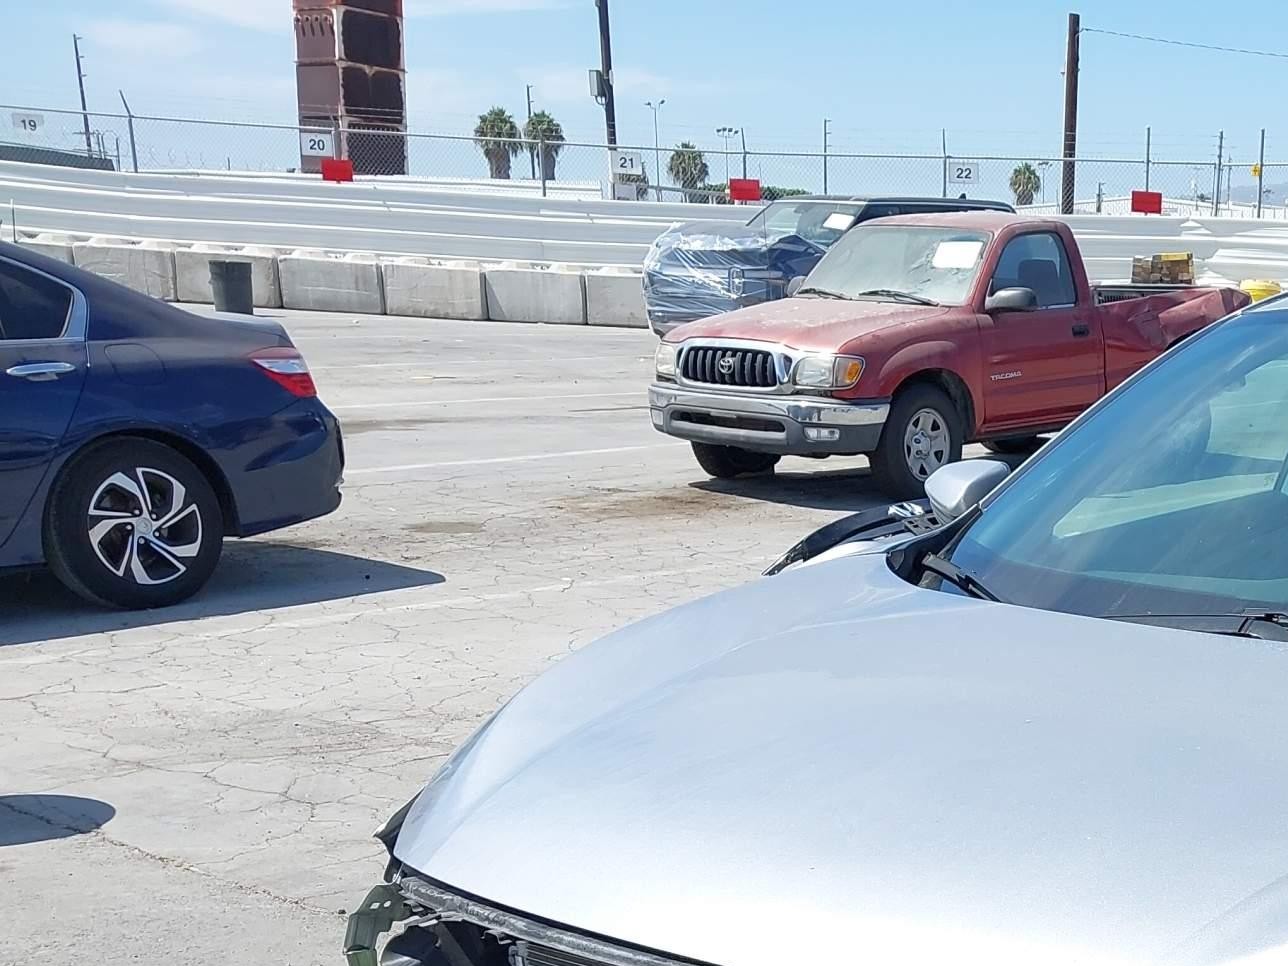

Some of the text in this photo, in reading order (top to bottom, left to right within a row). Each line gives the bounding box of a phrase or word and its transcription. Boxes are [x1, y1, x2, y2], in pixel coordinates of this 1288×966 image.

[21, 119, 37, 131] 19
[309, 138, 325, 151] 20
[619, 156, 634, 169] 21
[956, 167, 972, 179] 22
[990, 370, 1023, 381] TACOMA
